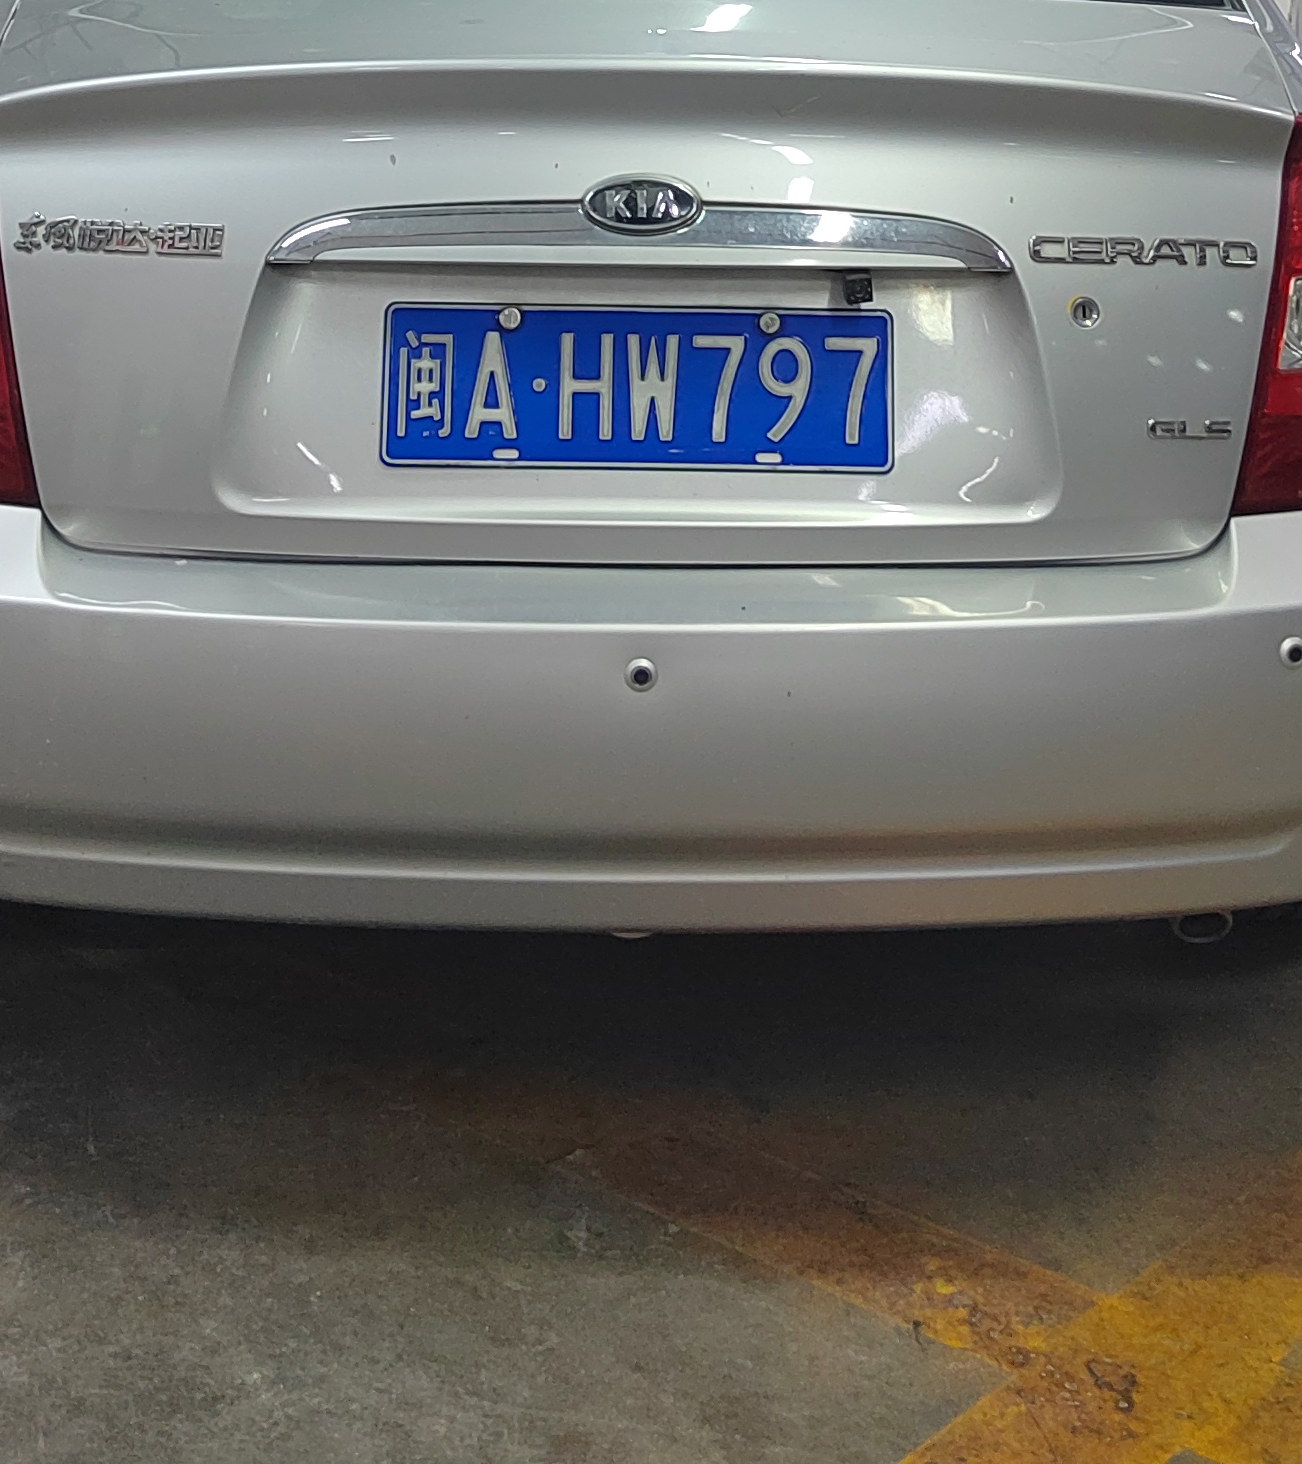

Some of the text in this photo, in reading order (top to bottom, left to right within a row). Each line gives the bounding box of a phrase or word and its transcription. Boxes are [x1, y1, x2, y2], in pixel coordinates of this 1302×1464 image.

[604, 188, 680, 218] KIA
[1028, 234, 1258, 268] CERATO
[1147, 418, 1233, 440] GLS
